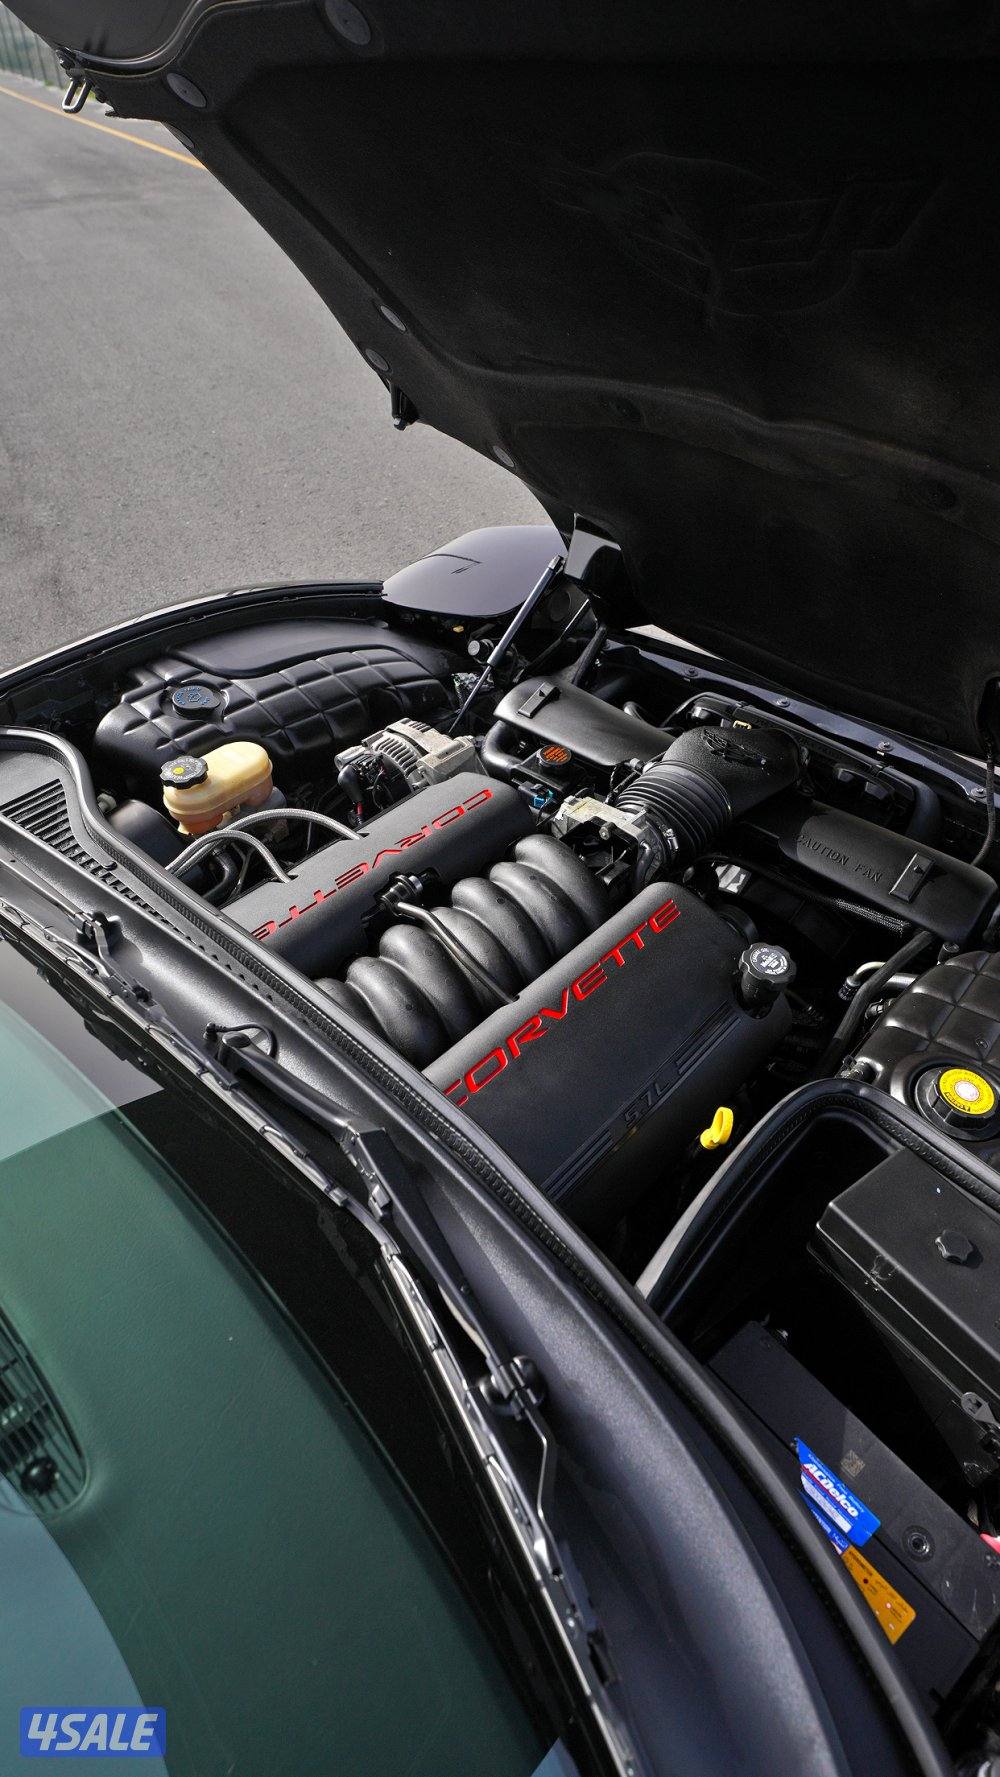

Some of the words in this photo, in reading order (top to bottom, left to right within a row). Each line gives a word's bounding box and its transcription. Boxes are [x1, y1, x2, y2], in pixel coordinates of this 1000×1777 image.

[797, 834, 850, 866] CAUTION
[854, 863, 883, 882] FAN
[803, 1463, 859, 1517] ACDelco
